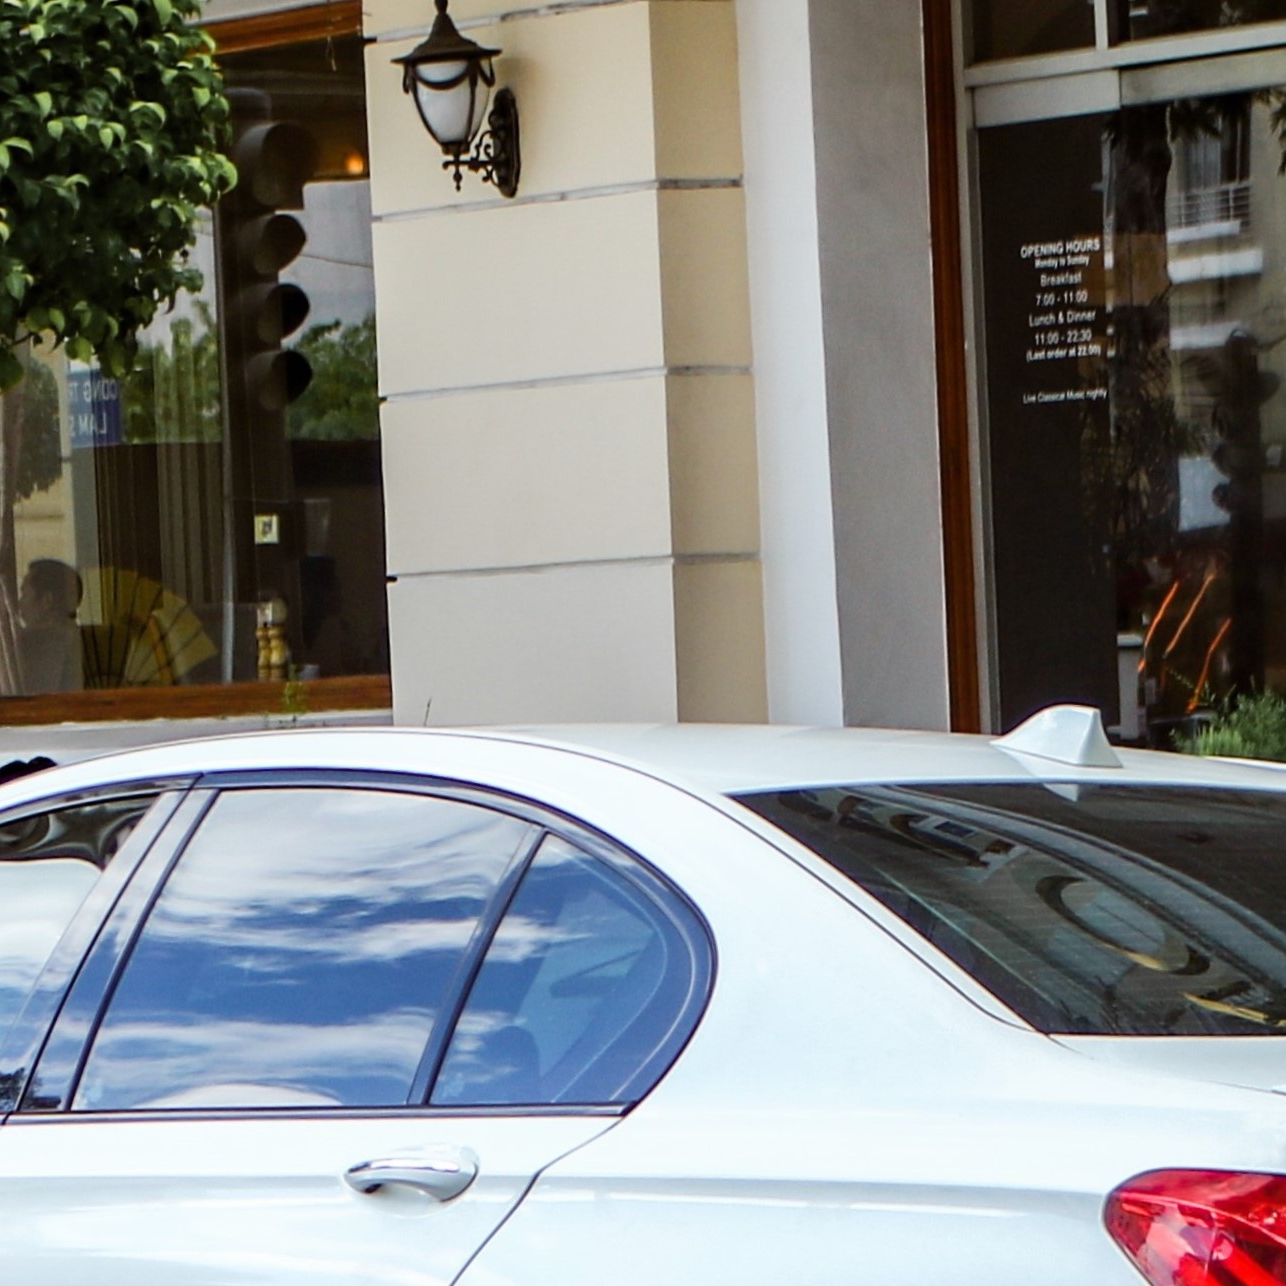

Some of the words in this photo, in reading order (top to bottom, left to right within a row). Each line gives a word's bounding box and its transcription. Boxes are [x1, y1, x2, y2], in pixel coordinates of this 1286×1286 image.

[1020, 241, 1064, 258] OPENING
[1066, 237, 1100, 253] HOURS
[1040, 270, 1082, 287] Breakfast
[1029, 311, 1056, 327] Lunch
[1066, 308, 1096, 323] Dinner
